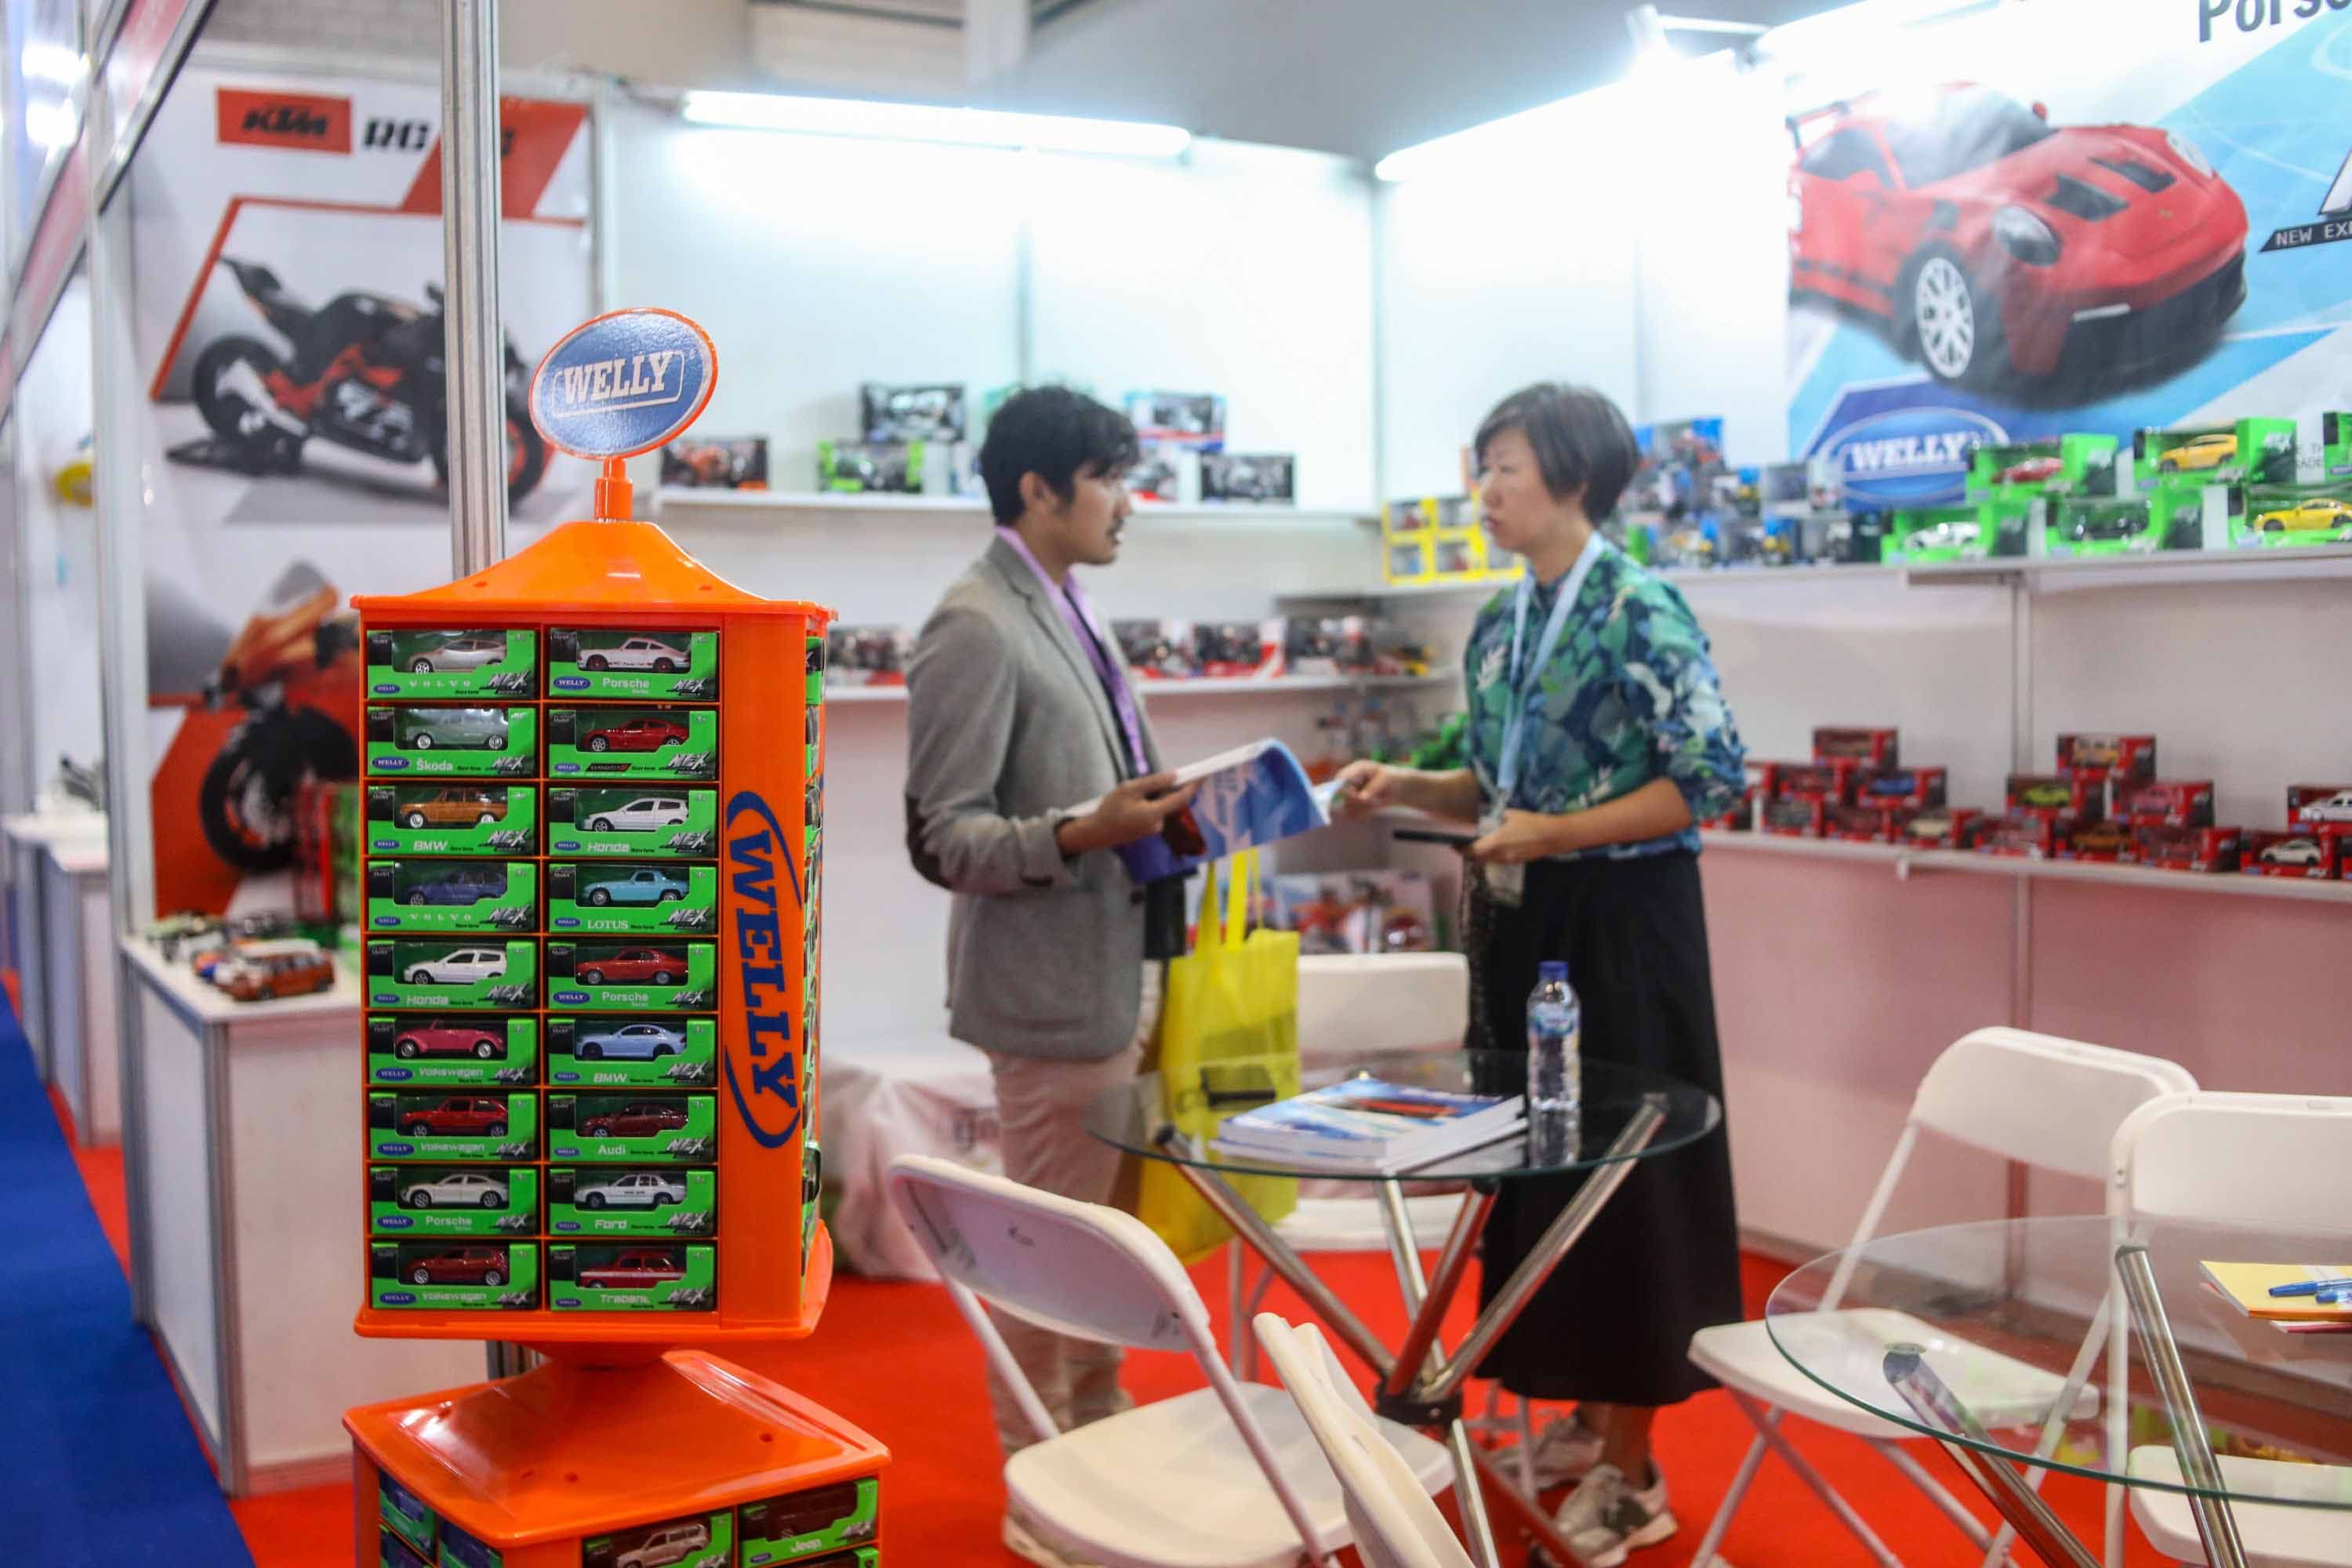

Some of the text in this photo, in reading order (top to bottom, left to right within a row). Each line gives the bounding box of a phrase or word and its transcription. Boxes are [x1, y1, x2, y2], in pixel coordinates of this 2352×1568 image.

[2199, 0, 2352, 42] Por
[2275, 220, 2352, 246] NEW EX
[564, 351, 674, 405] WELLY
[1851, 433, 1965, 470] WELLY
[488, 671, 529, 689] NEX
[603, 678, 649, 688] Porsche
[673, 678, 707, 691] NEX
[416, 758, 452, 771] Škoda
[494, 756, 525, 770] NEX
[669, 751, 709, 769] NEX
[488, 828, 529, 846] NEX
[669, 831, 710, 848] NEX
[414, 840, 448, 851] BMW
[588, 843, 630, 852] Honda
[489, 906, 532, 924] NEX
[669, 907, 709, 925] NEX
[729, 829, 797, 1109] WELLY
[488, 982, 528, 1001] NEX
[602, 992, 648, 1001] Porsche
[673, 991, 706, 1004] NEX
[407, 995, 448, 1005] Honda
[420, 1068, 483, 1078] Volkswagen
[666, 1061, 708, 1078] NEX
[593, 1073, 626, 1083] BMW
[421, 1143, 484, 1154] Volkswagen
[597, 1145, 625, 1154] Audi
[666, 1136, 707, 1154] NEX
[595, 1219, 626, 1229] Ford
[791, 1538, 821, 1554] Jeep
